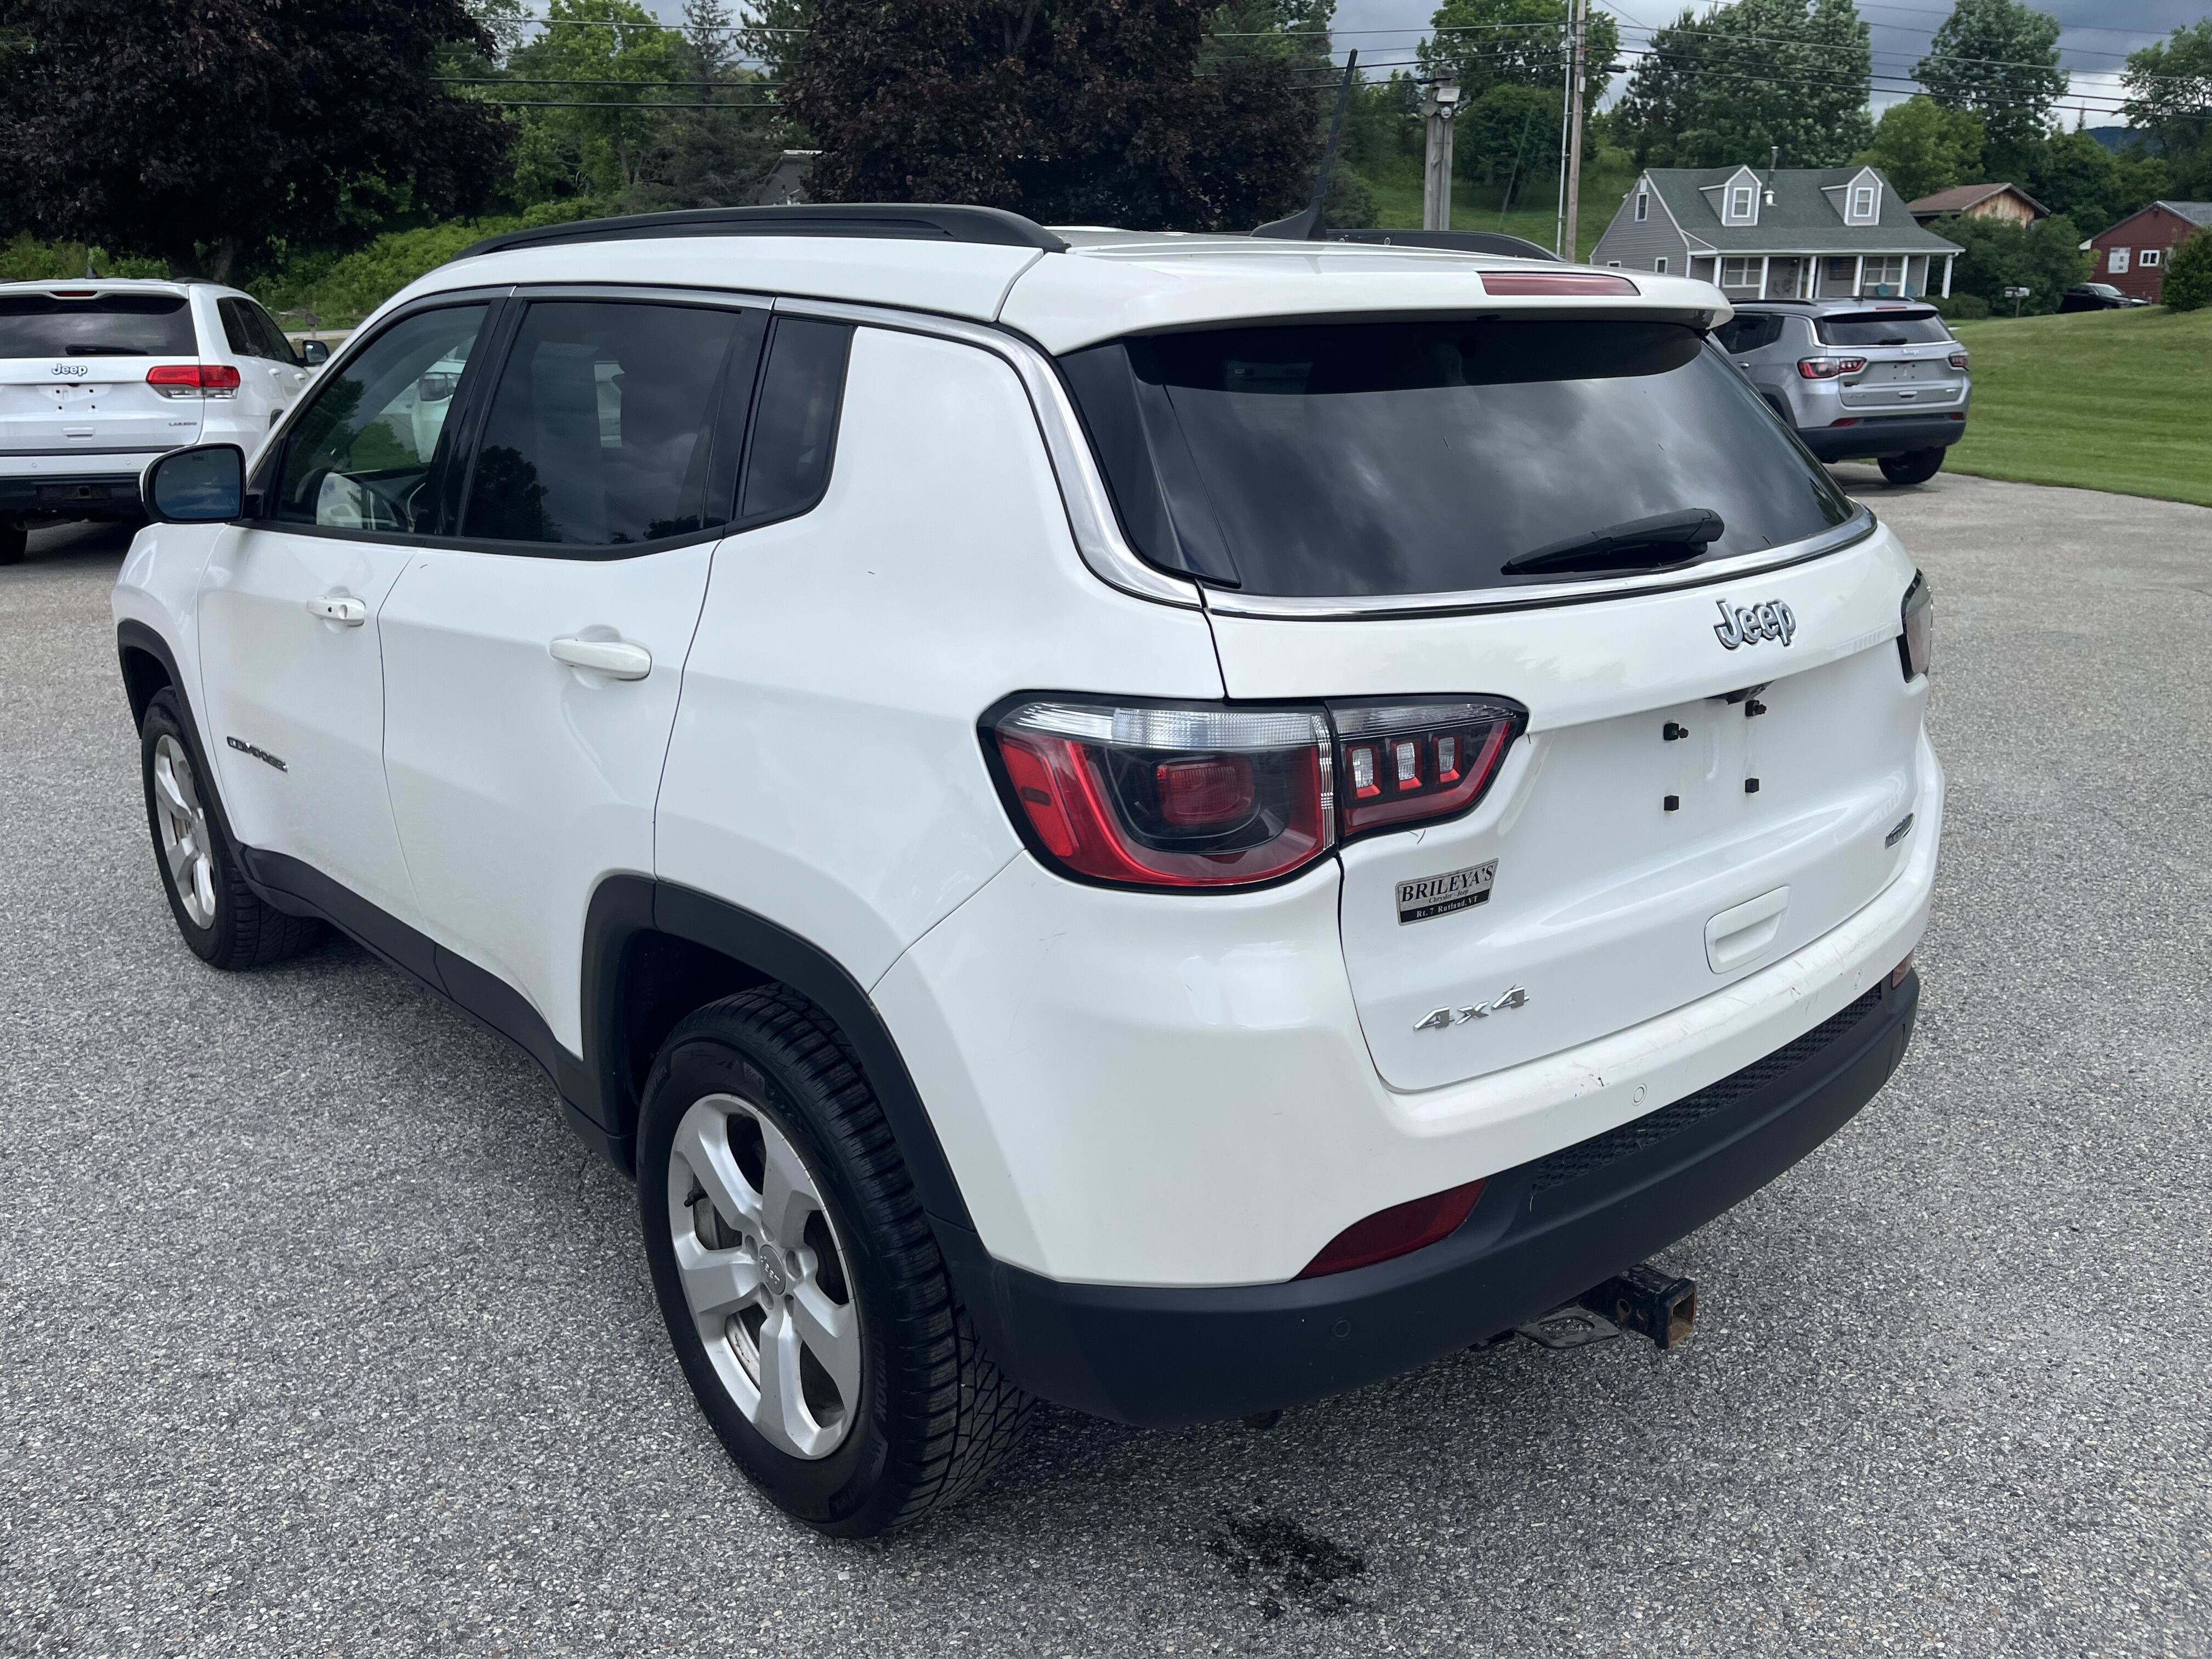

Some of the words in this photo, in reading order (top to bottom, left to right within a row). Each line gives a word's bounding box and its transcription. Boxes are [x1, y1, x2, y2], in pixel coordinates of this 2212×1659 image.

[51, 363, 88, 377] Jeep
[1713, 599, 1797, 650] Jeep
[1401, 865, 1493, 902] BRILEYA'S
[1429, 893, 1453, 904] Chrysler
[1417, 910, 1428, 918] Rt.
[1468, 895, 1478, 904] VT
[1413, 986, 1530, 1031] 4x4
